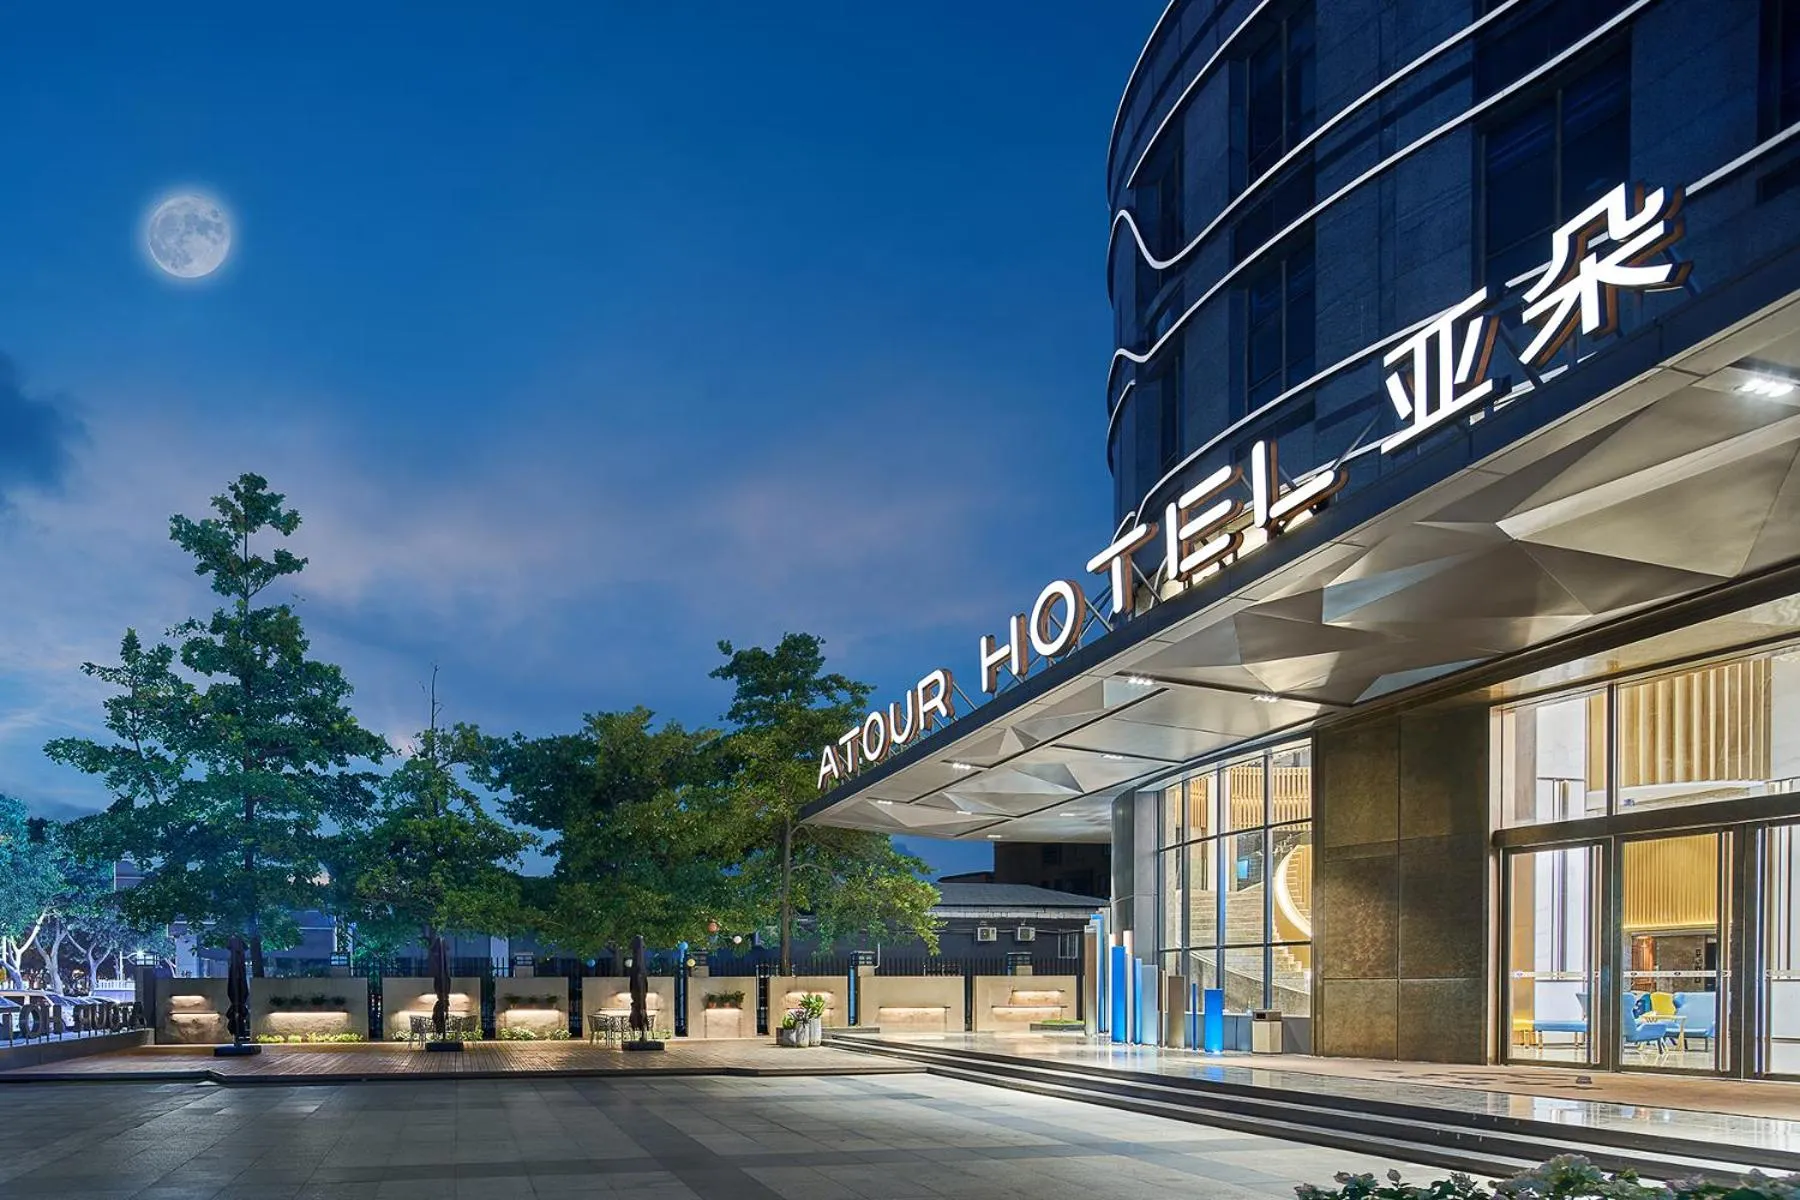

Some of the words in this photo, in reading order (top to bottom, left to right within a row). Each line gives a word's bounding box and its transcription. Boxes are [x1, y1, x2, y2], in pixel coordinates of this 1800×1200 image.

[1380, 181, 1680, 456] 亚朵
[816, 668, 953, 790] ATOUR
[979, 439, 1342, 694] HOTEL
